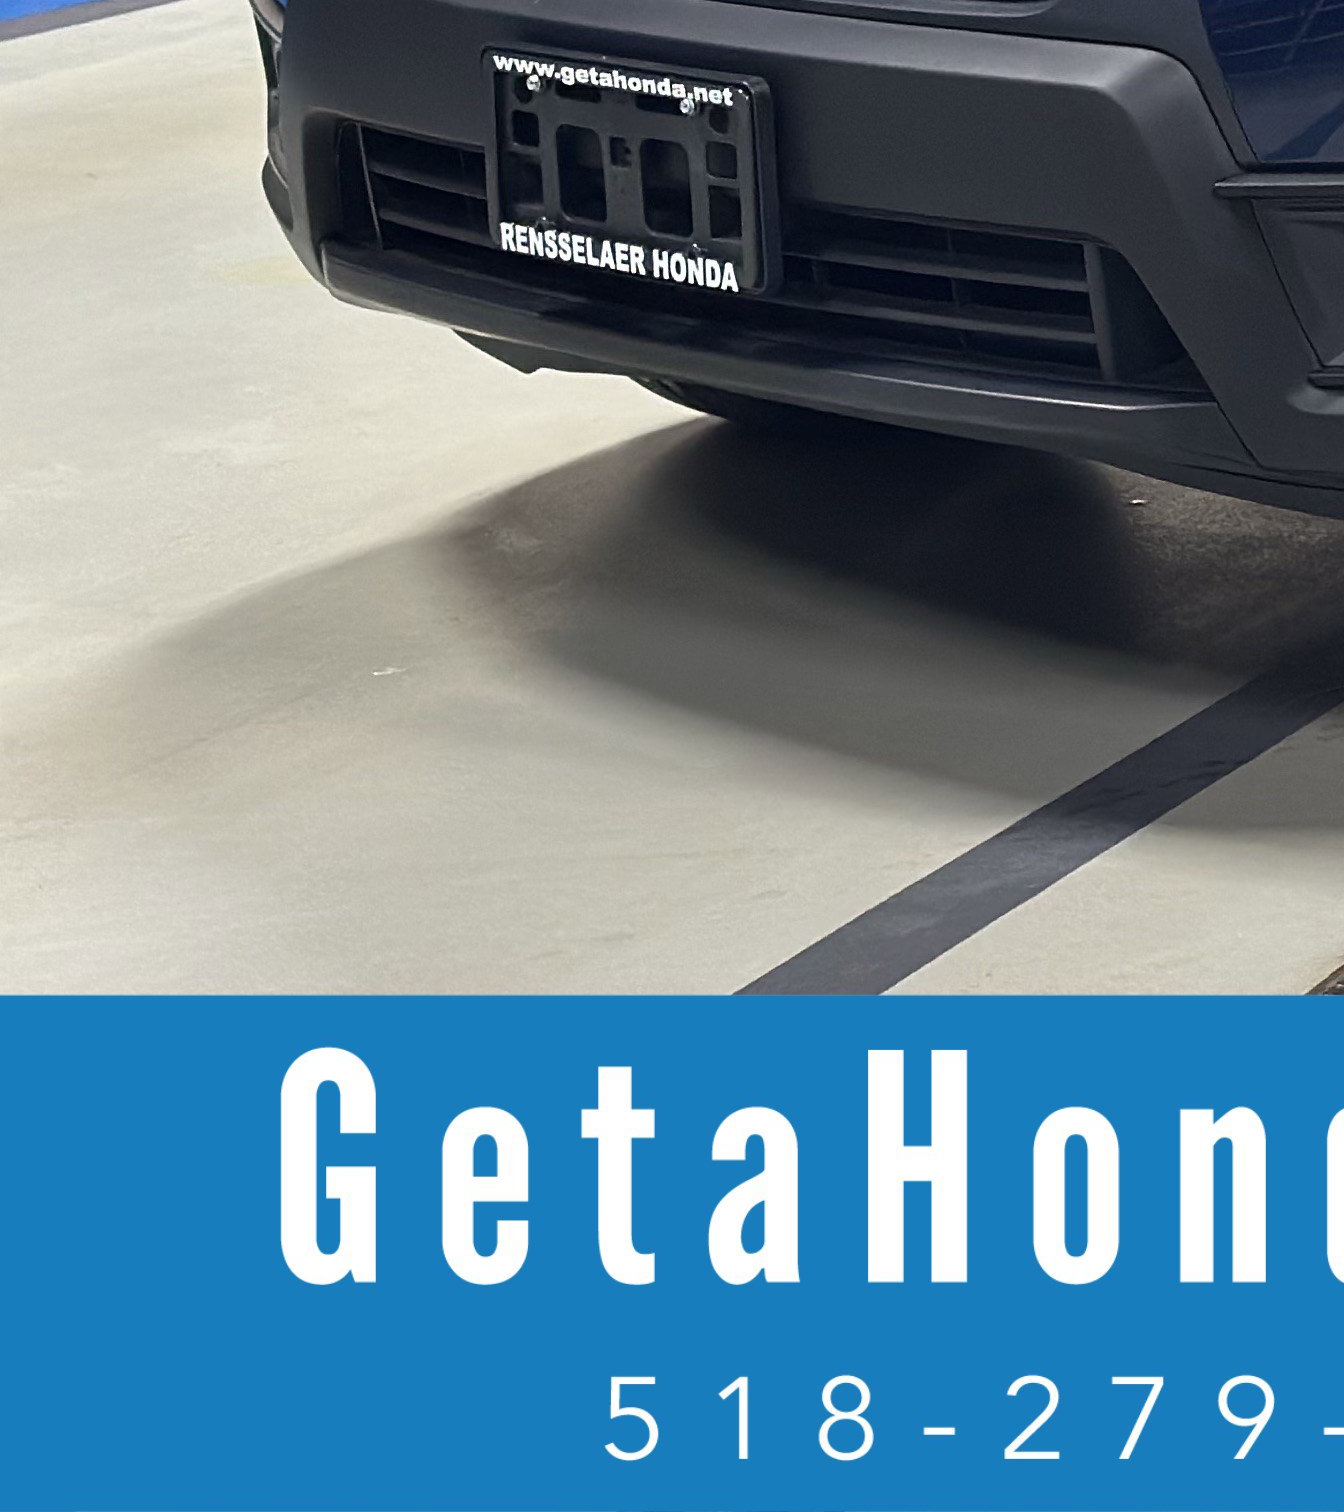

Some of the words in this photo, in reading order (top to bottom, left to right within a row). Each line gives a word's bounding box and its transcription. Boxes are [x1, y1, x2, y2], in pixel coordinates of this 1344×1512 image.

[492, 54, 734, 107] www.getahonda.net
[499, 221, 646, 276] RENSSELAER
[651, 248, 739, 293] HONDA
